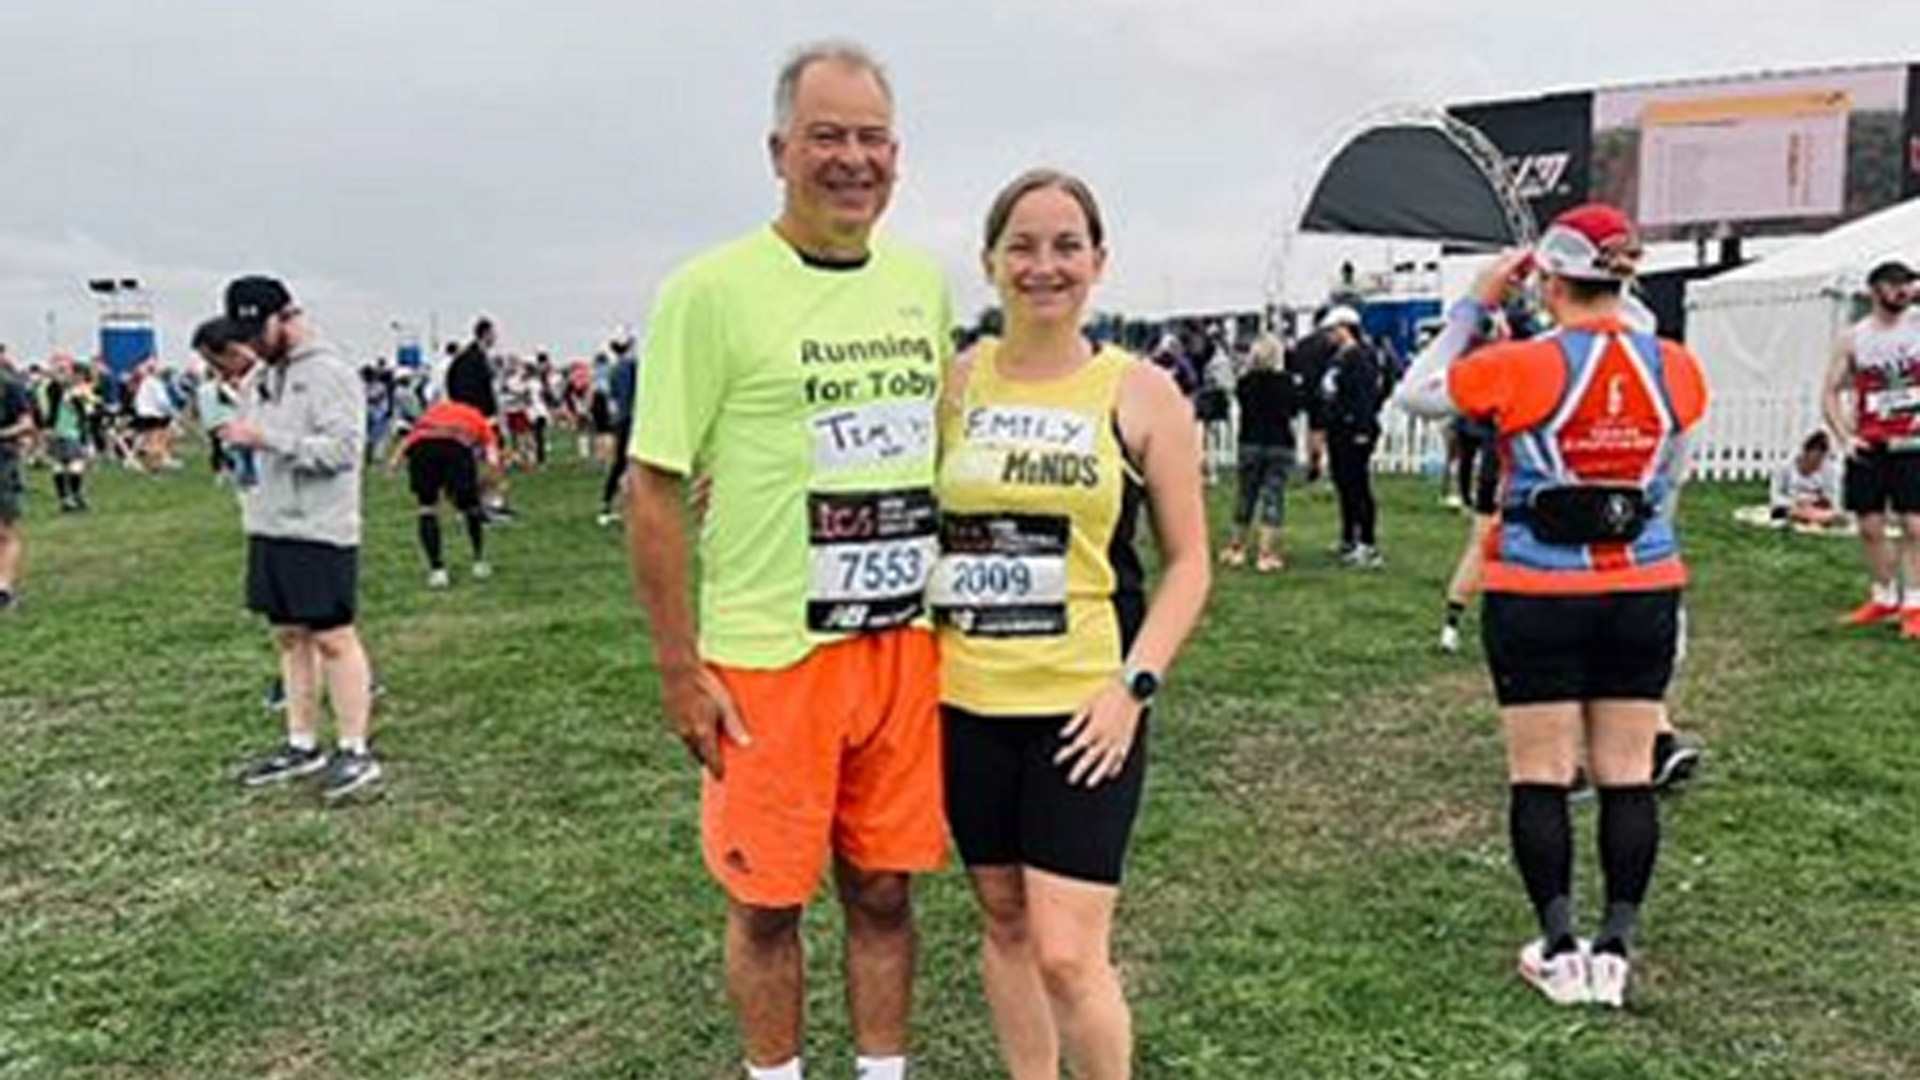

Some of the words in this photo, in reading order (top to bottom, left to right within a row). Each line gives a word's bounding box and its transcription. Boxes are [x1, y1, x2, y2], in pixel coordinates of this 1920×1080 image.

[801, 335, 933, 364] Running
[805, 375, 859, 403] for
[867, 369, 936, 399] Toby
[964, 406, 1084, 443] EMILY
[838, 548, 921, 591] 7553
[952, 561, 1031, 596] 2009
